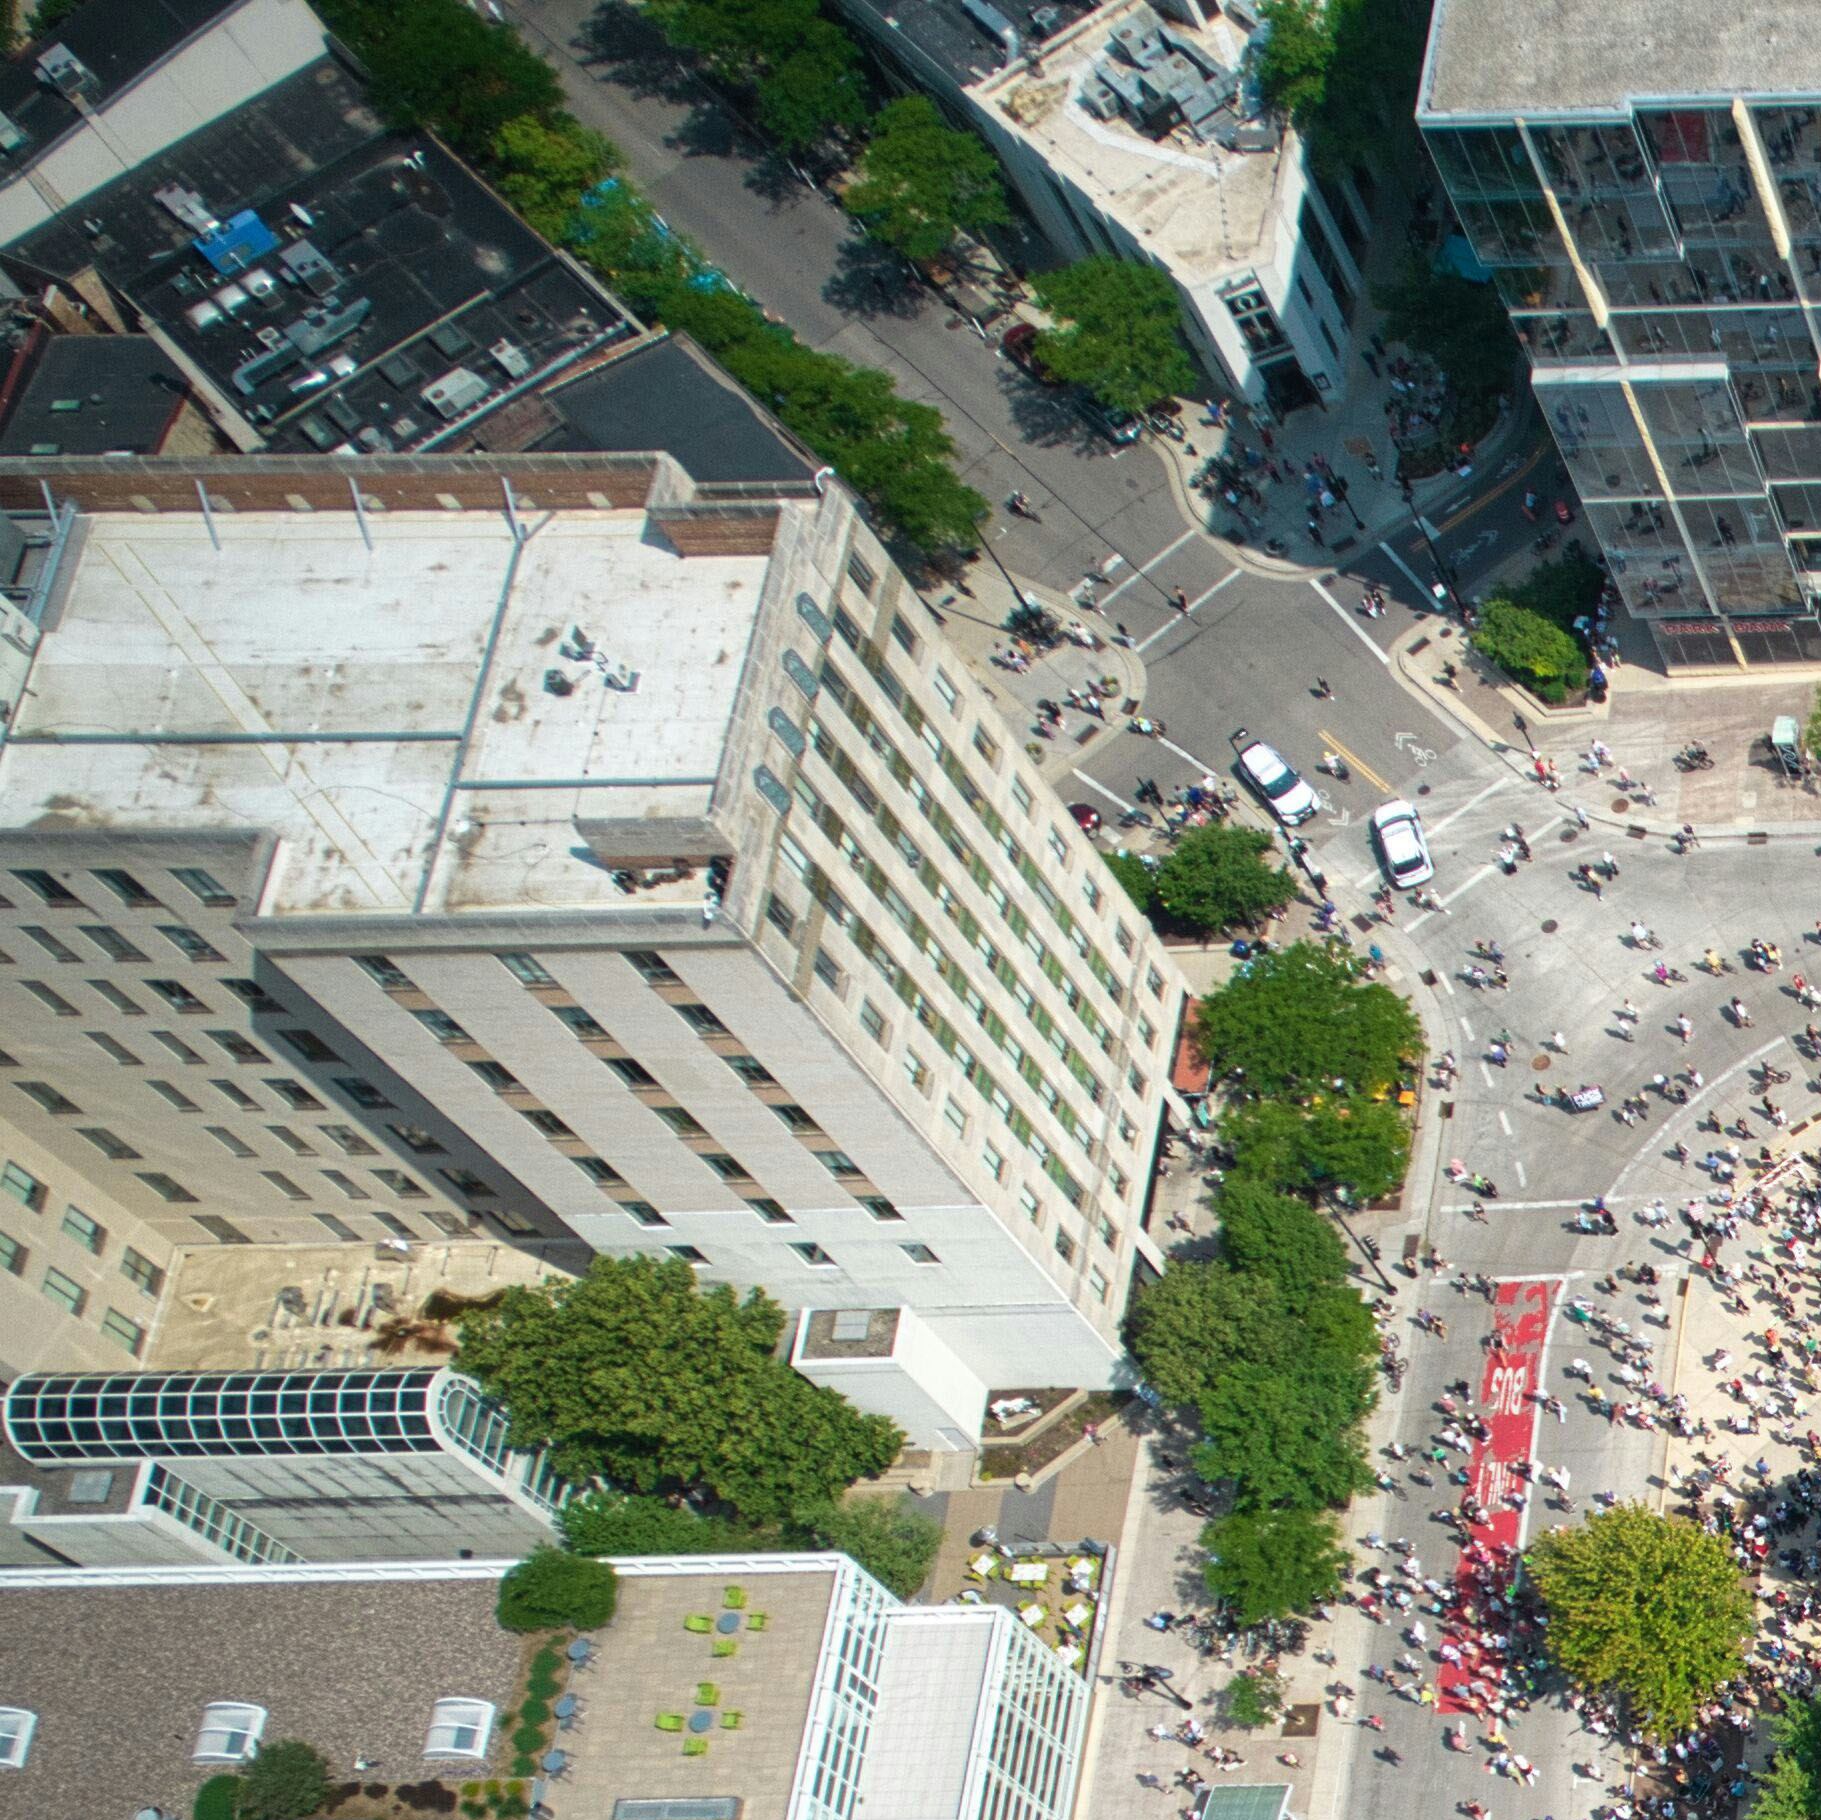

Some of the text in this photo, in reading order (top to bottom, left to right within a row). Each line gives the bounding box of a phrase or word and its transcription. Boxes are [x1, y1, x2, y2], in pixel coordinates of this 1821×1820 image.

[1661, 621, 1792, 635] PARK BANK
[1489, 1366, 1527, 1416] BUS
